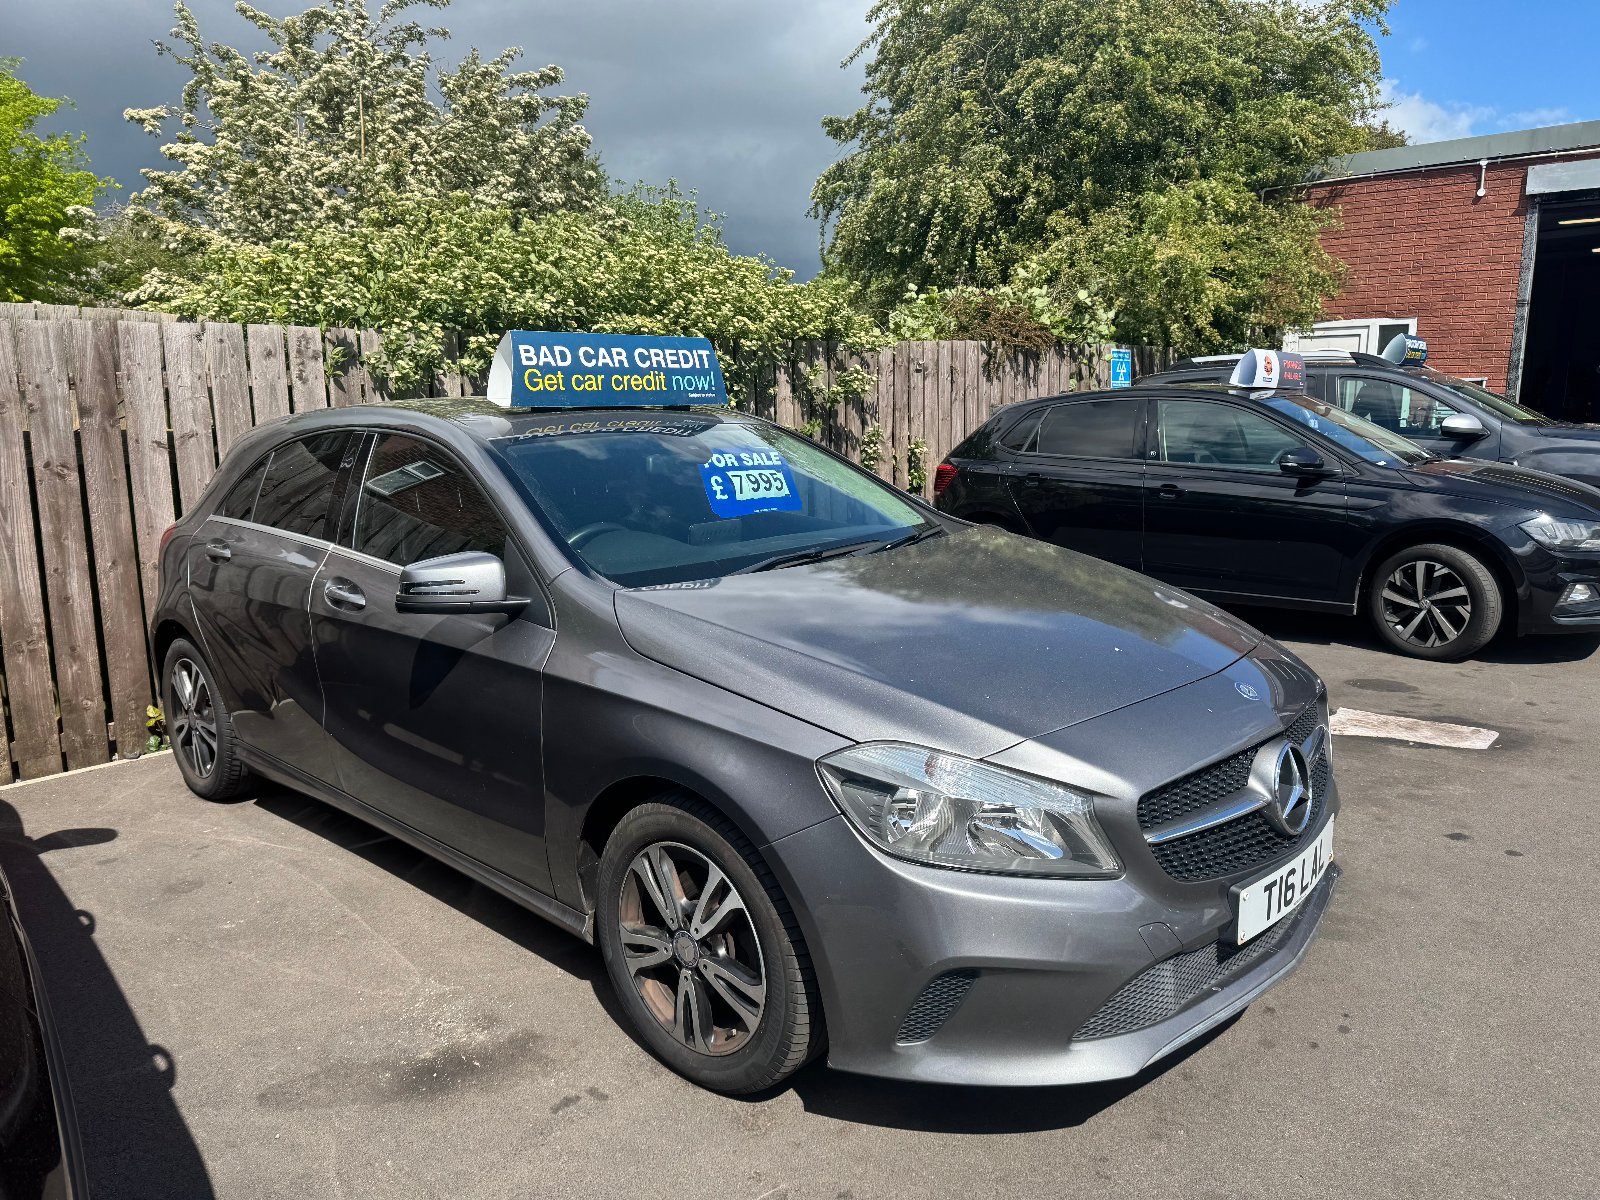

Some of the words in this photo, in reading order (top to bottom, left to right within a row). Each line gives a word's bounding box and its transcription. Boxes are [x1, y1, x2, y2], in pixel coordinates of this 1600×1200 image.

[518, 345, 572, 367] BAD
[578, 346, 629, 368] CAR
[634, 348, 711, 369] CREDIT
[524, 368, 566, 391] Get
[571, 374, 605, 391] car
[611, 371, 668, 391] credit
[672, 371, 716, 391] now!
[740, 452, 782, 466] SALE
[710, 475, 729, 500] £
[731, 472, 784, 495] 7995
[1263, 867, 1297, 922] T16
[1300, 839, 1325, 896] LAL
